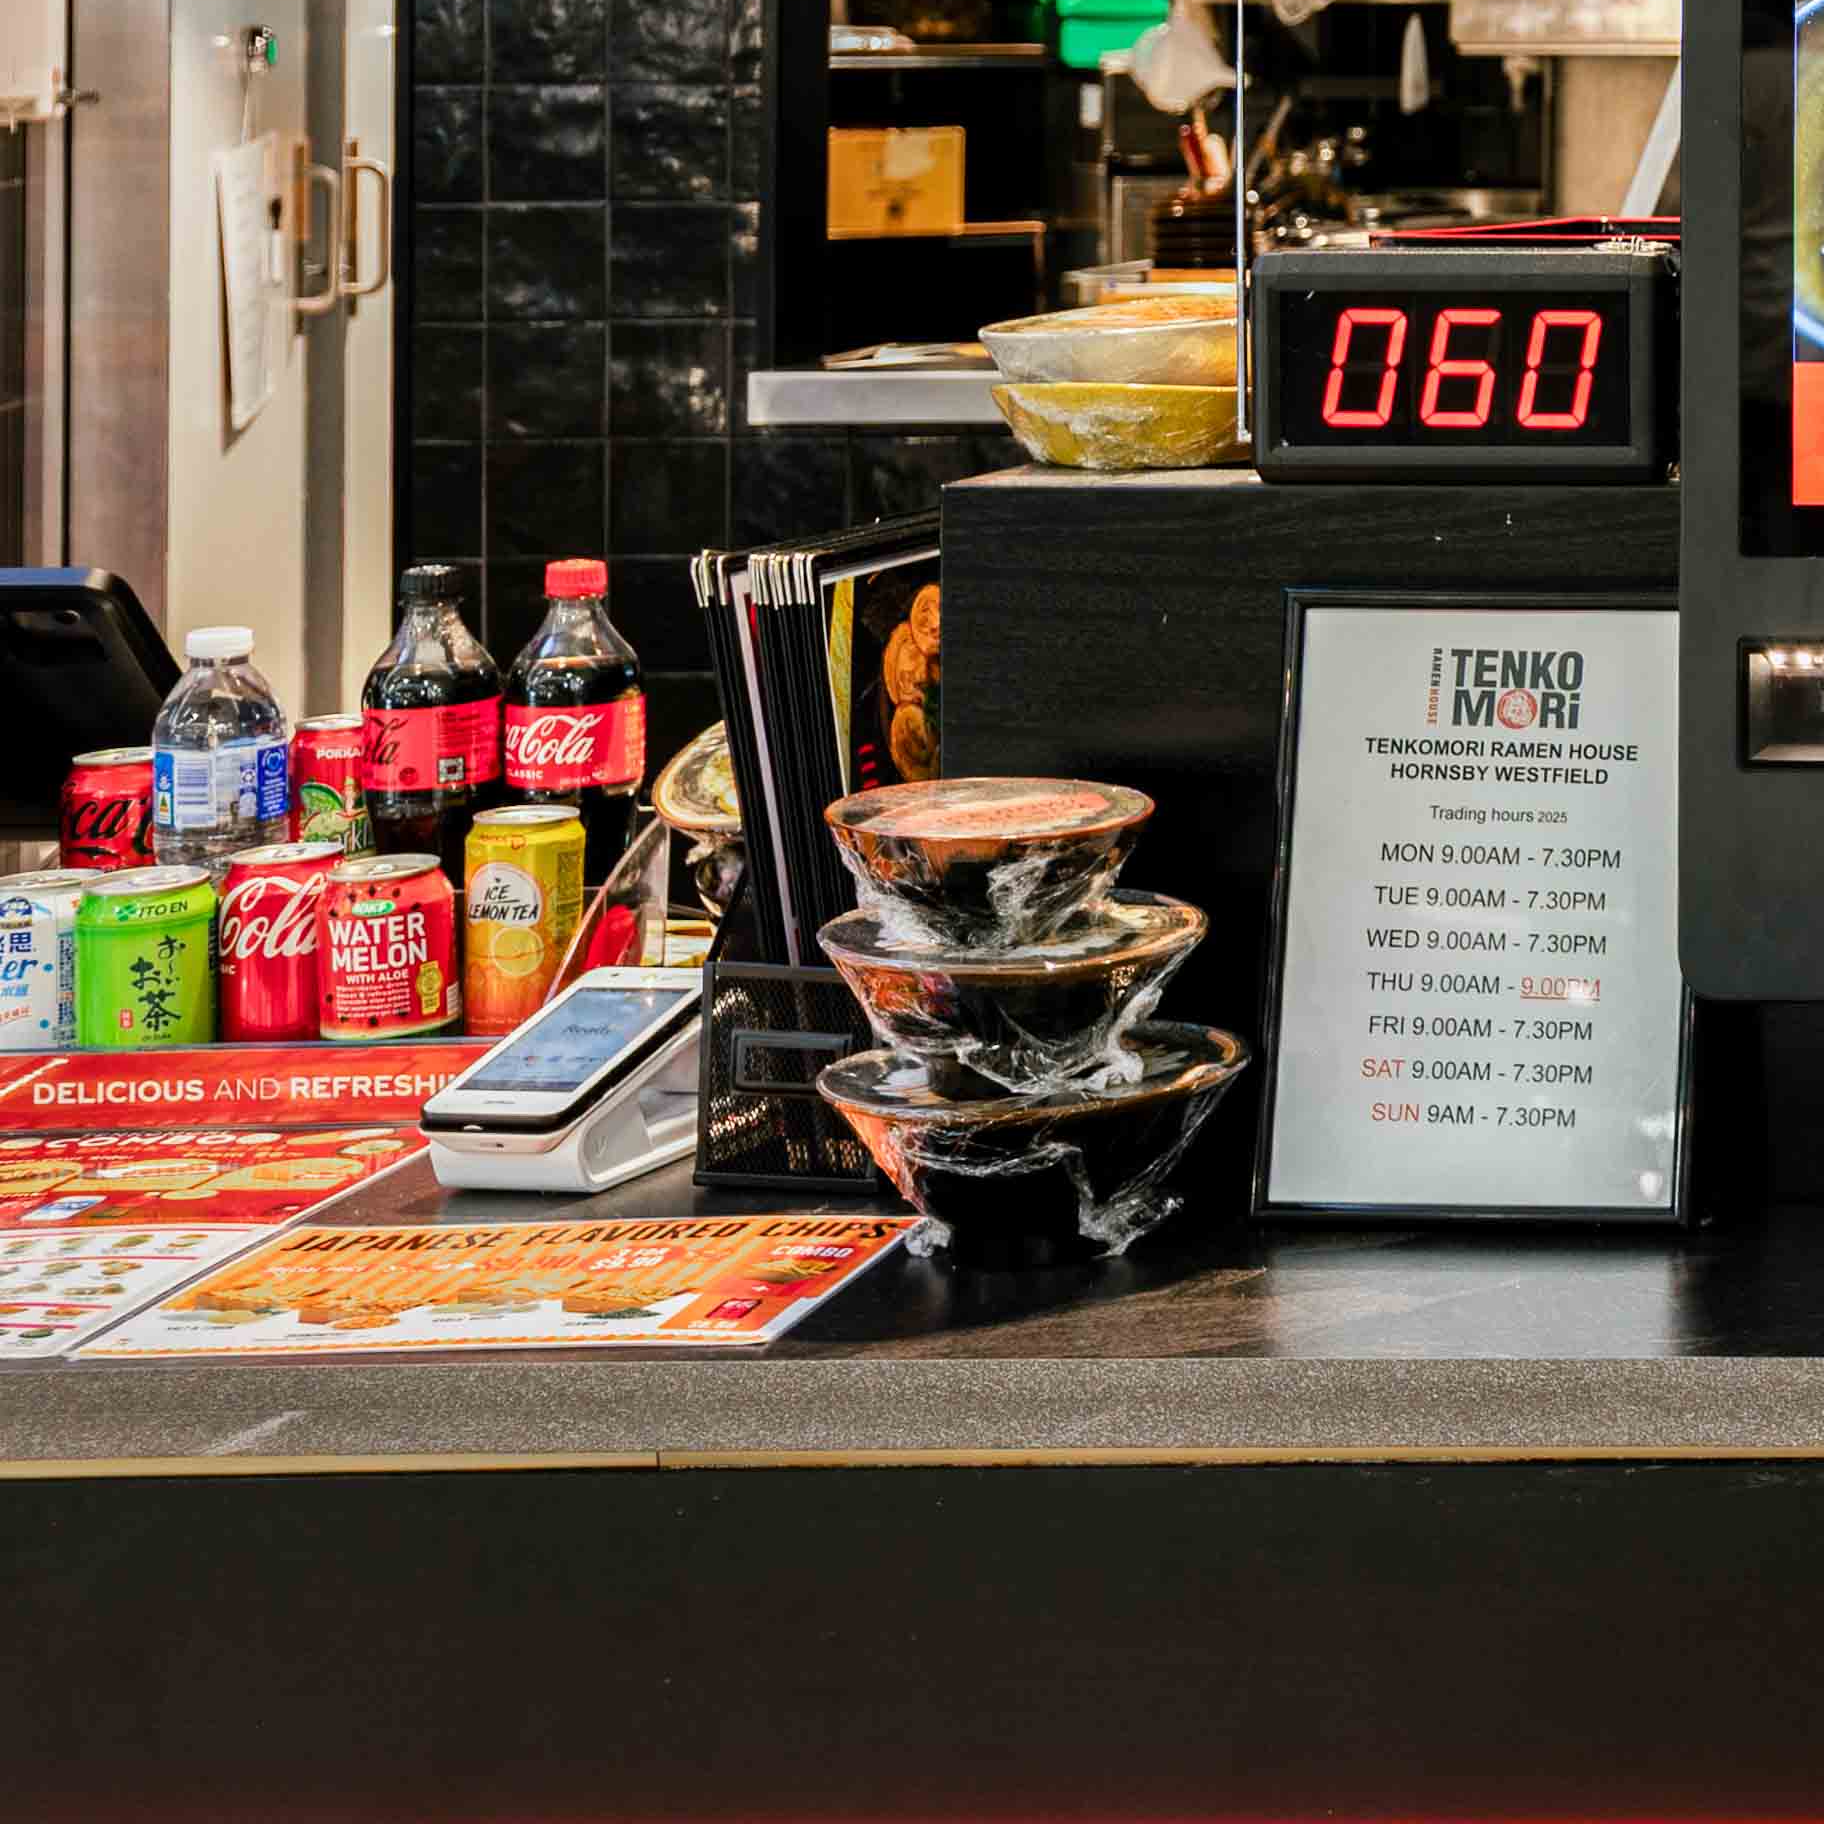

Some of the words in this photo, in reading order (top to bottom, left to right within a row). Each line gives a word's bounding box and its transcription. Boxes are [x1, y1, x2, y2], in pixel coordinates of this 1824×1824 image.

[1321, 307, 1602, 430] 060
[1451, 648, 1585, 692] TENKO
[1365, 737, 1485, 757] TENKOMORI
[1491, 741, 1563, 759] RAMEN
[1569, 743, 1639, 761] HOUSE
[507, 768, 544, 780] LASSIC
[1390, 763, 1489, 781] HORNSBY
[1495, 766, 1609, 785] WESTFIELD
[1430, 805, 1487, 824] Trading
[1491, 807, 1534, 823] hours
[1537, 810, 1568, 824] 2025
[1381, 843, 1434, 863] MON
[1441, 845, 1520, 865] 9.00AM
[1542, 847, 1621, 869] 7.30PM
[484, 884, 512, 902] ICE
[1375, 885, 1419, 905] TUE
[1426, 887, 1506, 908] 9.00AM
[1527, 890, 1606, 911] 7.30PM
[139, 904, 166, 919] ITO
[169, 900, 188, 913] EN
[468, 906, 508, 922] LEMON
[512, 904, 539, 921] TEA
[328, 912, 426, 945] WATER
[1367, 928, 1419, 948] WED
[1427, 931, 1506, 951] 9.00AM
[1528, 934, 1607, 955] 7.30PM
[331, 938, 428, 973] MELON
[346, 974, 375, 985] WITH
[378, 968, 409, 982] ALOE
[1367, 972, 1413, 992] THU
[1420, 974, 1500, 995] 9.00AM
[1369, 1015, 1405, 1035] FRI
[1412, 1017, 1492, 1038] 9.00AM
[1513, 1020, 1593, 1041] 7.30PM
[1361, 1058, 1406, 1078] SAT
[1411, 1060, 1491, 1081] 9.00AM
[1513, 1063, 1593, 1084] 7.30PM
[33, 1079, 205, 1105] DELICIOUS
[213, 1078, 281, 1101] AND
[289, 1072, 456, 1101] REFRESHI
[1371, 1102, 1420, 1121] SUN
[1427, 1104, 1475, 1124] 9AM
[1496, 1106, 1576, 1127] 7.30PM
[280, 1230, 516, 1252] JAPANESE
[520, 1222, 751, 1247] FLAVORED
[759, 1221, 902, 1240] CHIPS
[770, 1245, 855, 1259] COMBO
